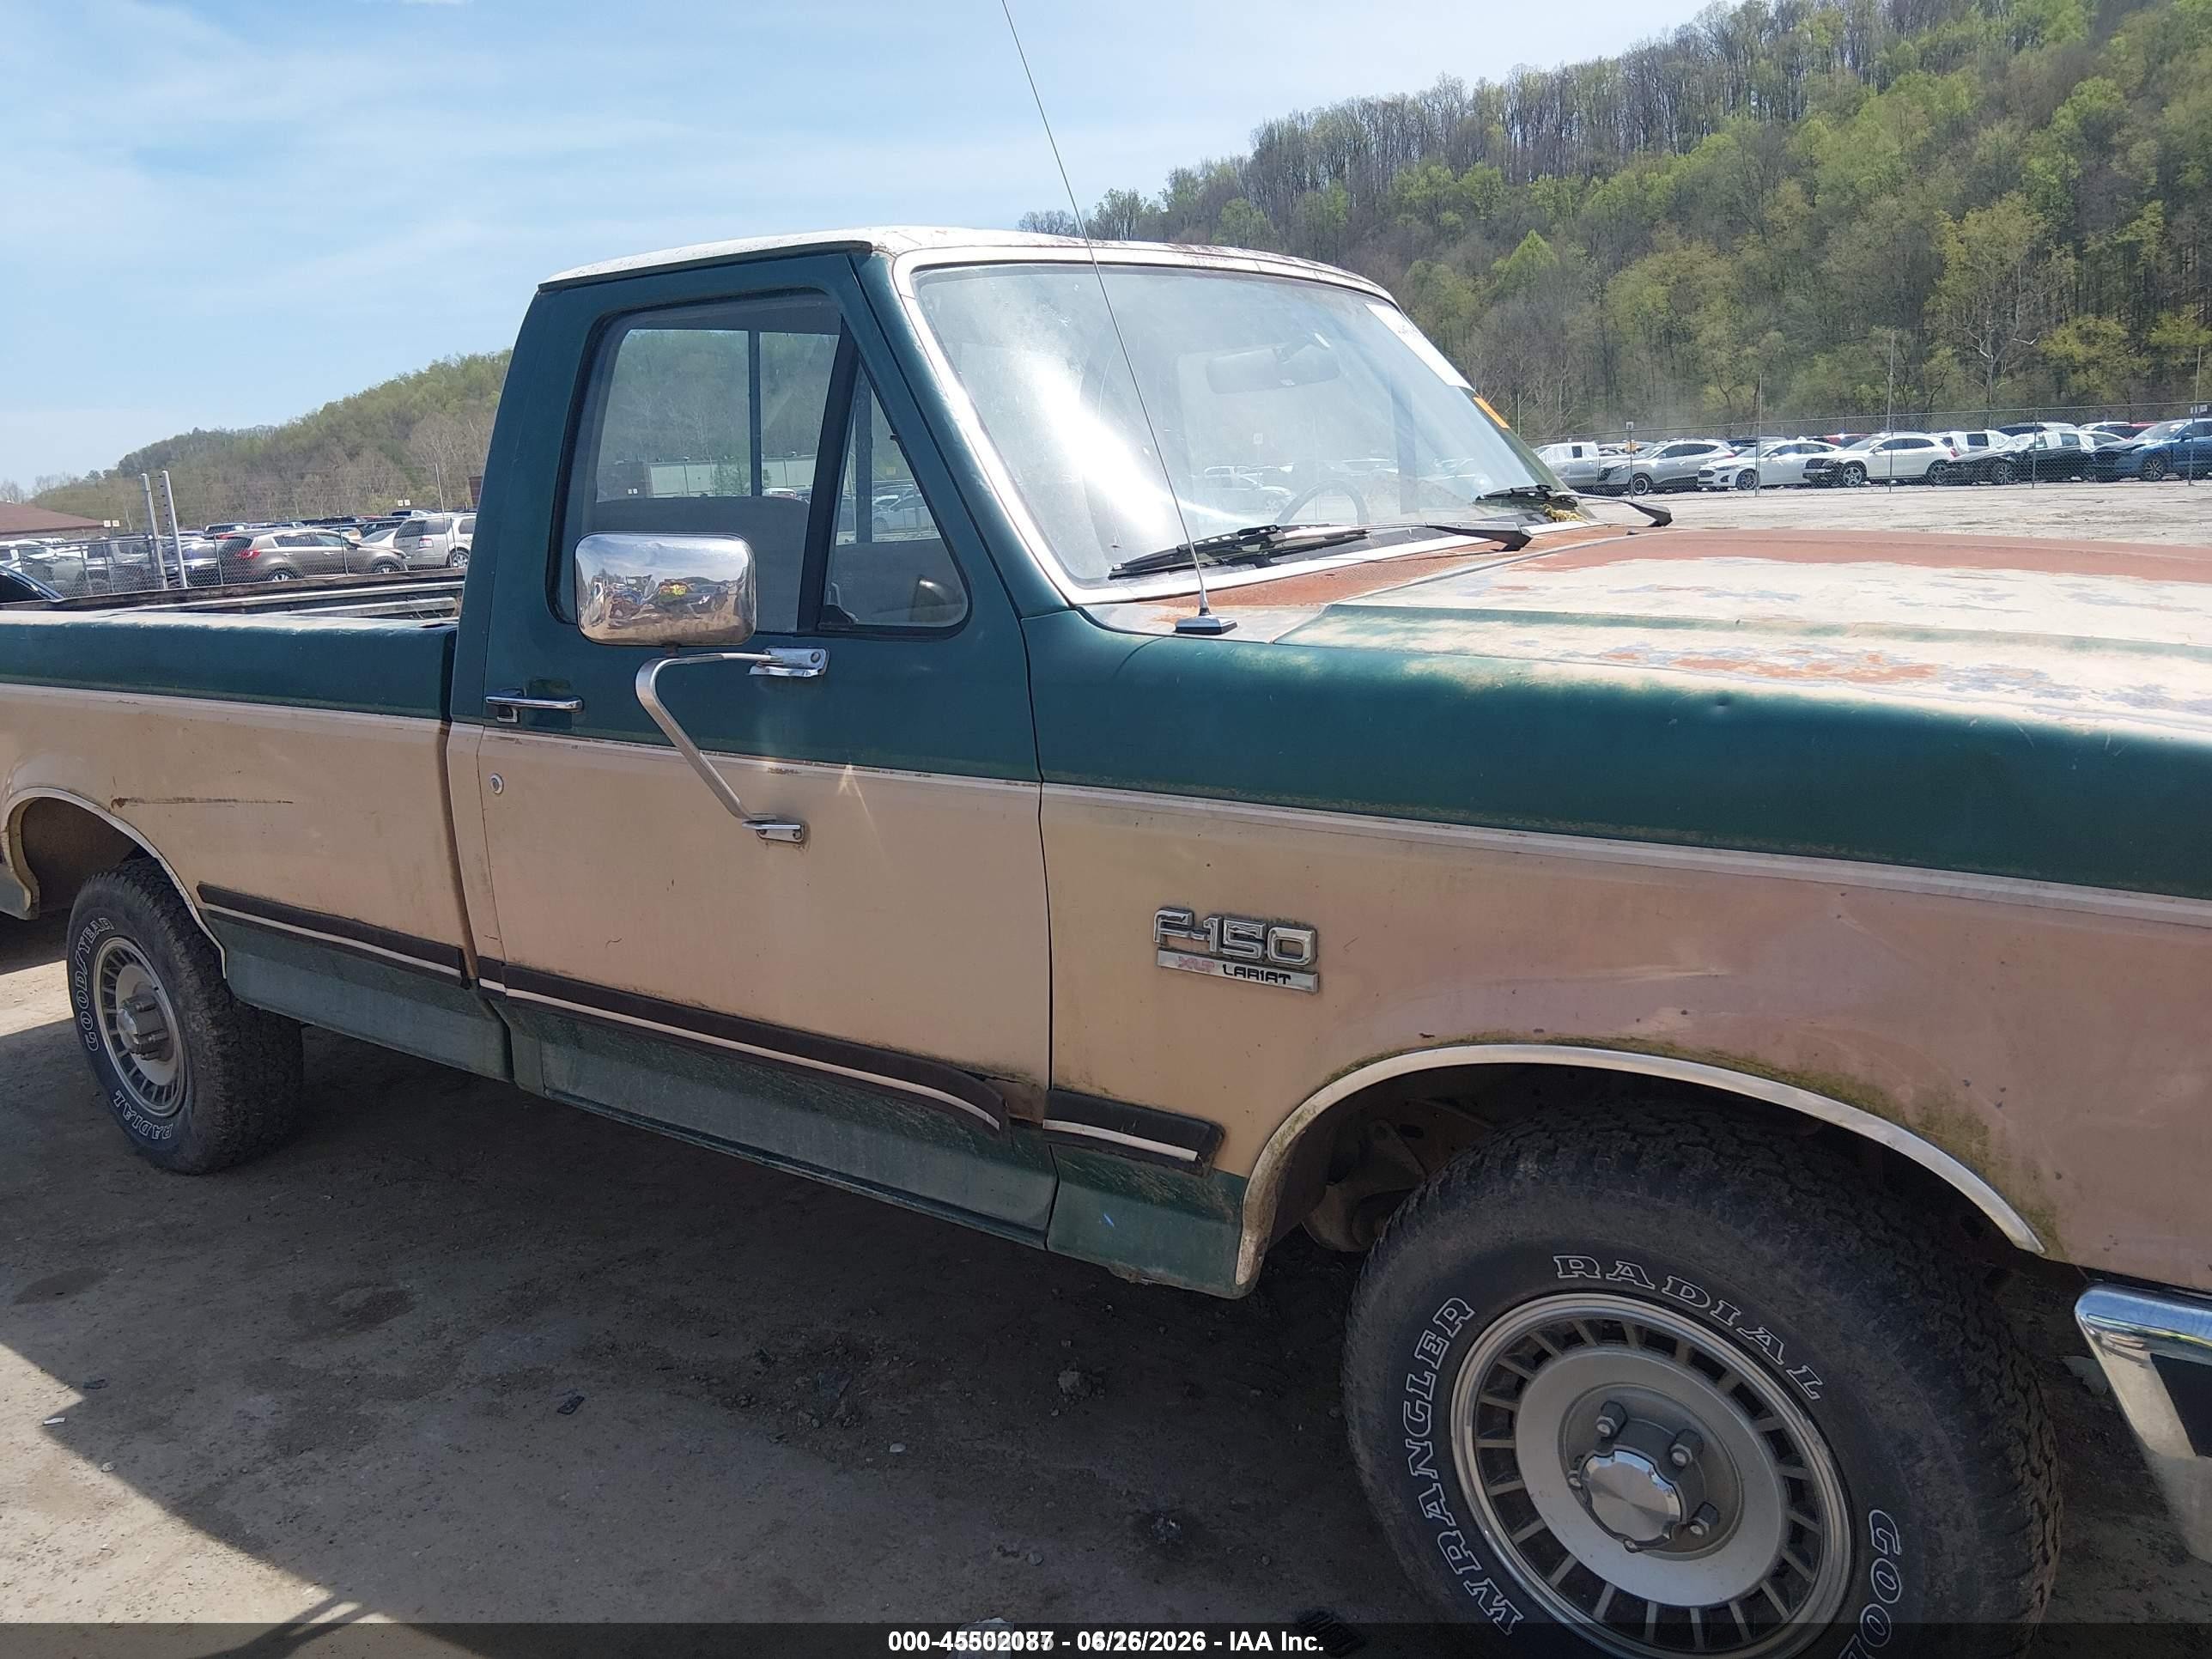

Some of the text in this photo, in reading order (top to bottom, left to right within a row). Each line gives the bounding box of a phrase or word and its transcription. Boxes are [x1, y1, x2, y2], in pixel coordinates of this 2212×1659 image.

[1153, 906, 1317, 967] F-150
[1222, 963, 1291, 985] LARIAT
[113, 1090, 173, 1139] RADIAL
[1403, 1255, 1823, 1636] WRANGLER RADIAL
